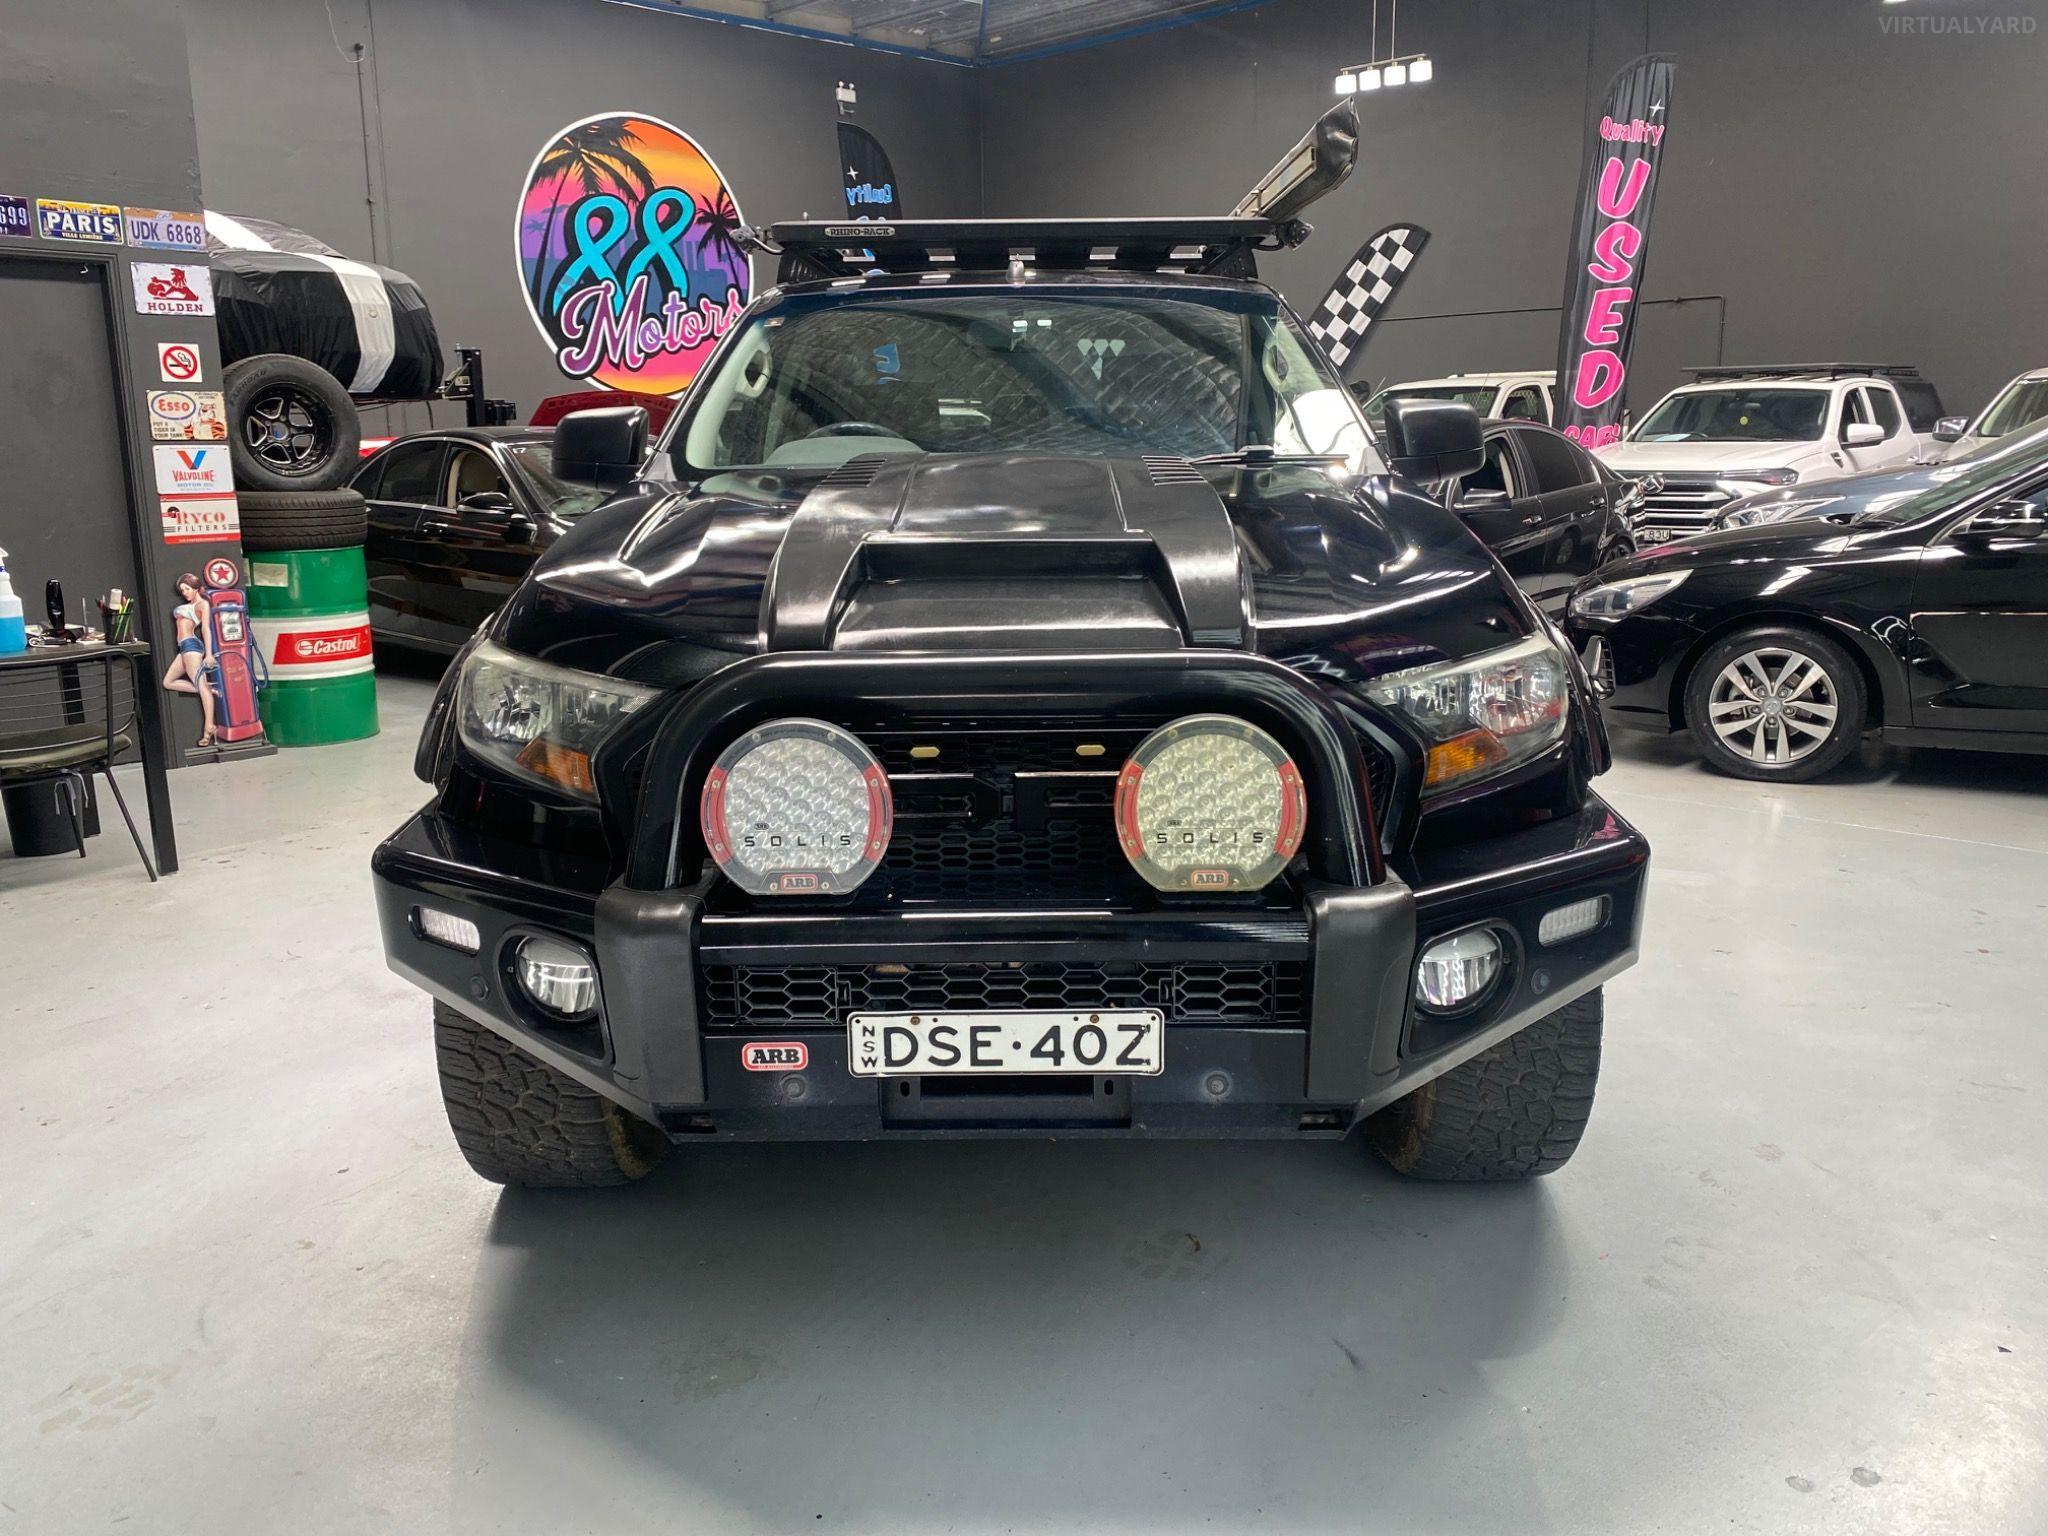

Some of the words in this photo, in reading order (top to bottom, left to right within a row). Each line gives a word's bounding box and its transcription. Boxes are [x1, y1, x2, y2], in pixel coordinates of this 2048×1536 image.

[1600, 115, 1665, 147] Quality
[46, 211, 116, 234] PARIS
[131, 220, 160, 241] UDK
[166, 223, 202, 245] 6868
[830, 227, 890, 236] RHINO-RACK
[552, 187, 695, 318] 88
[1573, 156, 1652, 410] USED
[147, 302, 203, 313] HOLDEN
[559, 274, 745, 370] Motors
[172, 469, 215, 482] VALVOLINE
[176, 511, 226, 524] RYCO
[177, 524, 227, 532] FILTERS
[313, 636, 358, 655] Castrol
[744, 835, 851, 847] SOLIS
[1156, 832, 1265, 844] SOLIS
[785, 877, 815, 888] ARB
[1195, 873, 1225, 884] ARB
[752, 1048, 800, 1064] ARB
